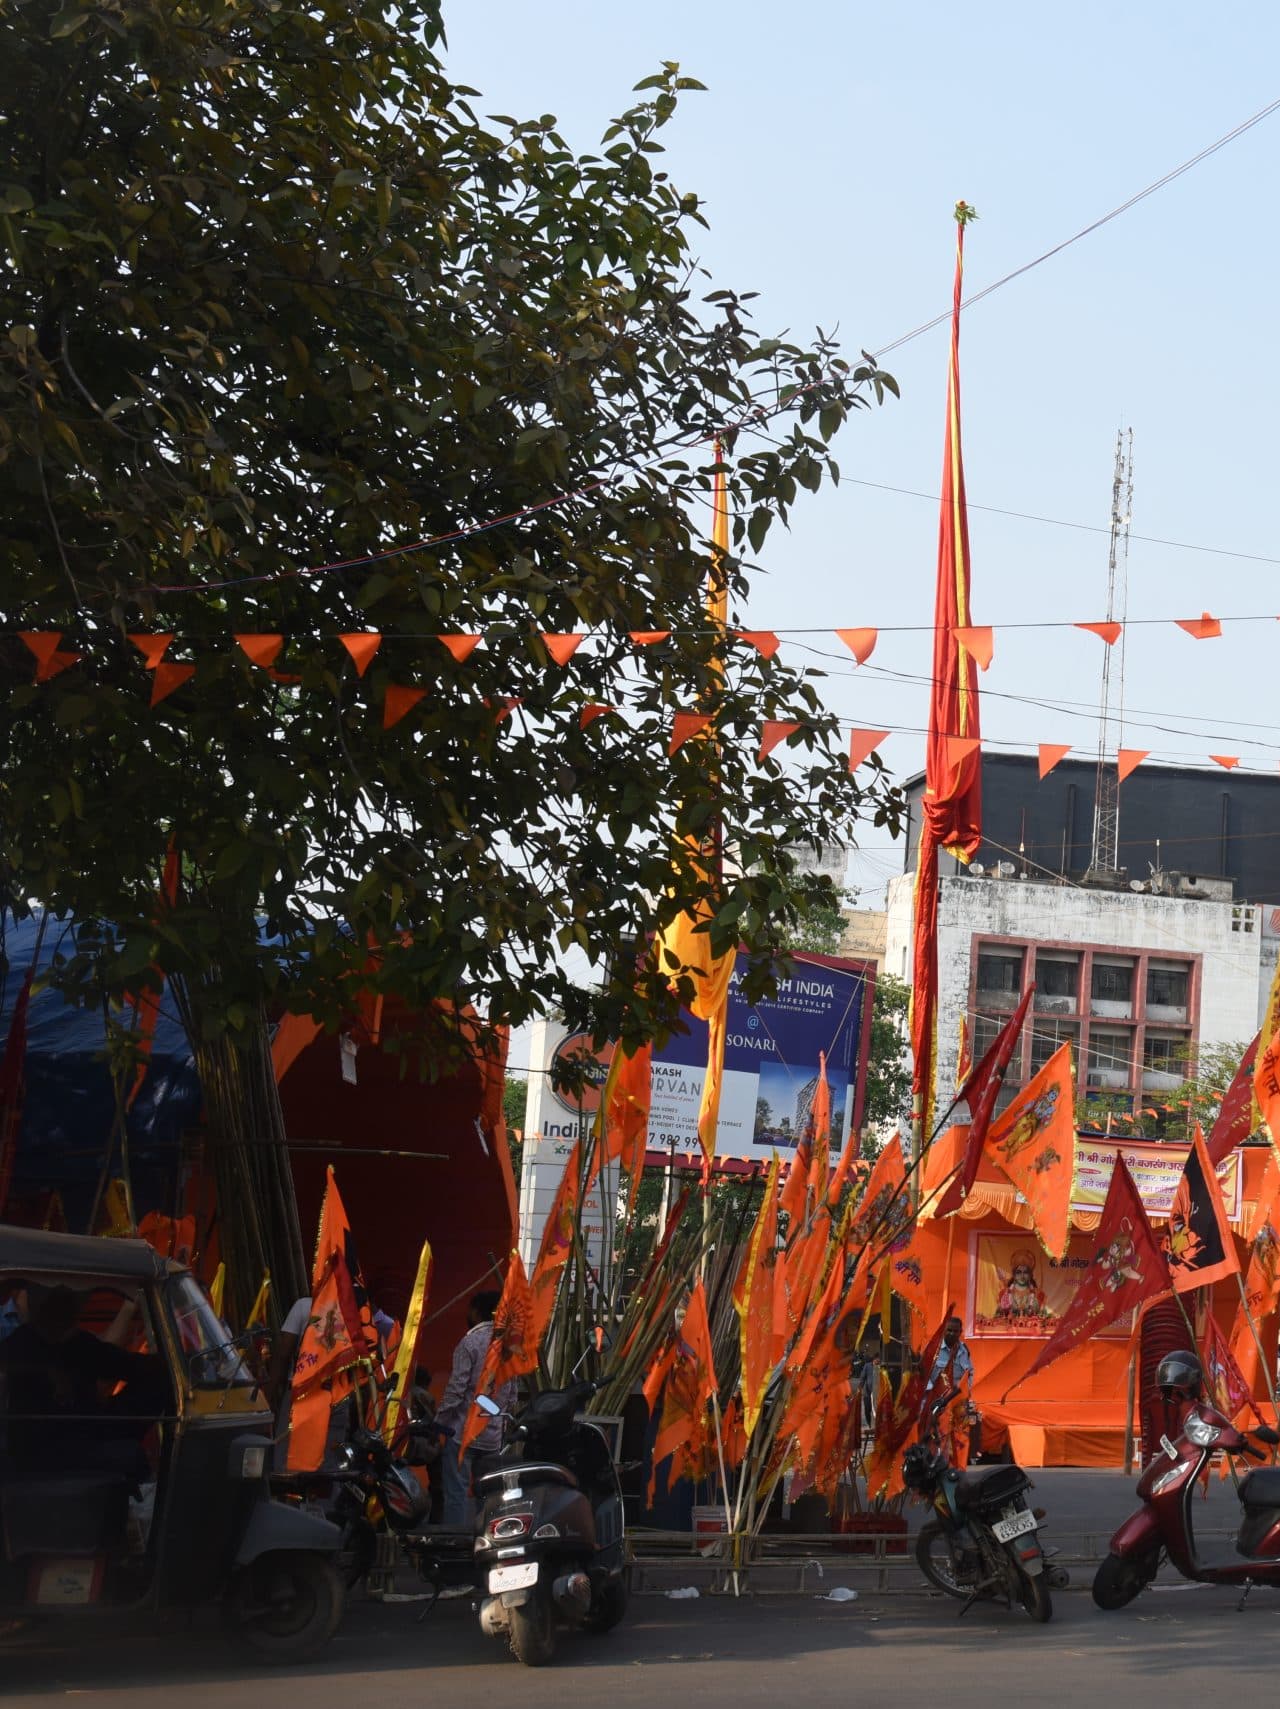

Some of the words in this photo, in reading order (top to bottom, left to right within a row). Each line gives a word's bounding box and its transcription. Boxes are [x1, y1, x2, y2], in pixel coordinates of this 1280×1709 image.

[796, 980, 834, 998] INDIA
[777, 995, 832, 1009] LIFESTYLES
[726, 1033, 776, 1051] SONARI
[650, 1067, 682, 1077] AKASH
[650, 1078, 701, 1096] IRVAN
